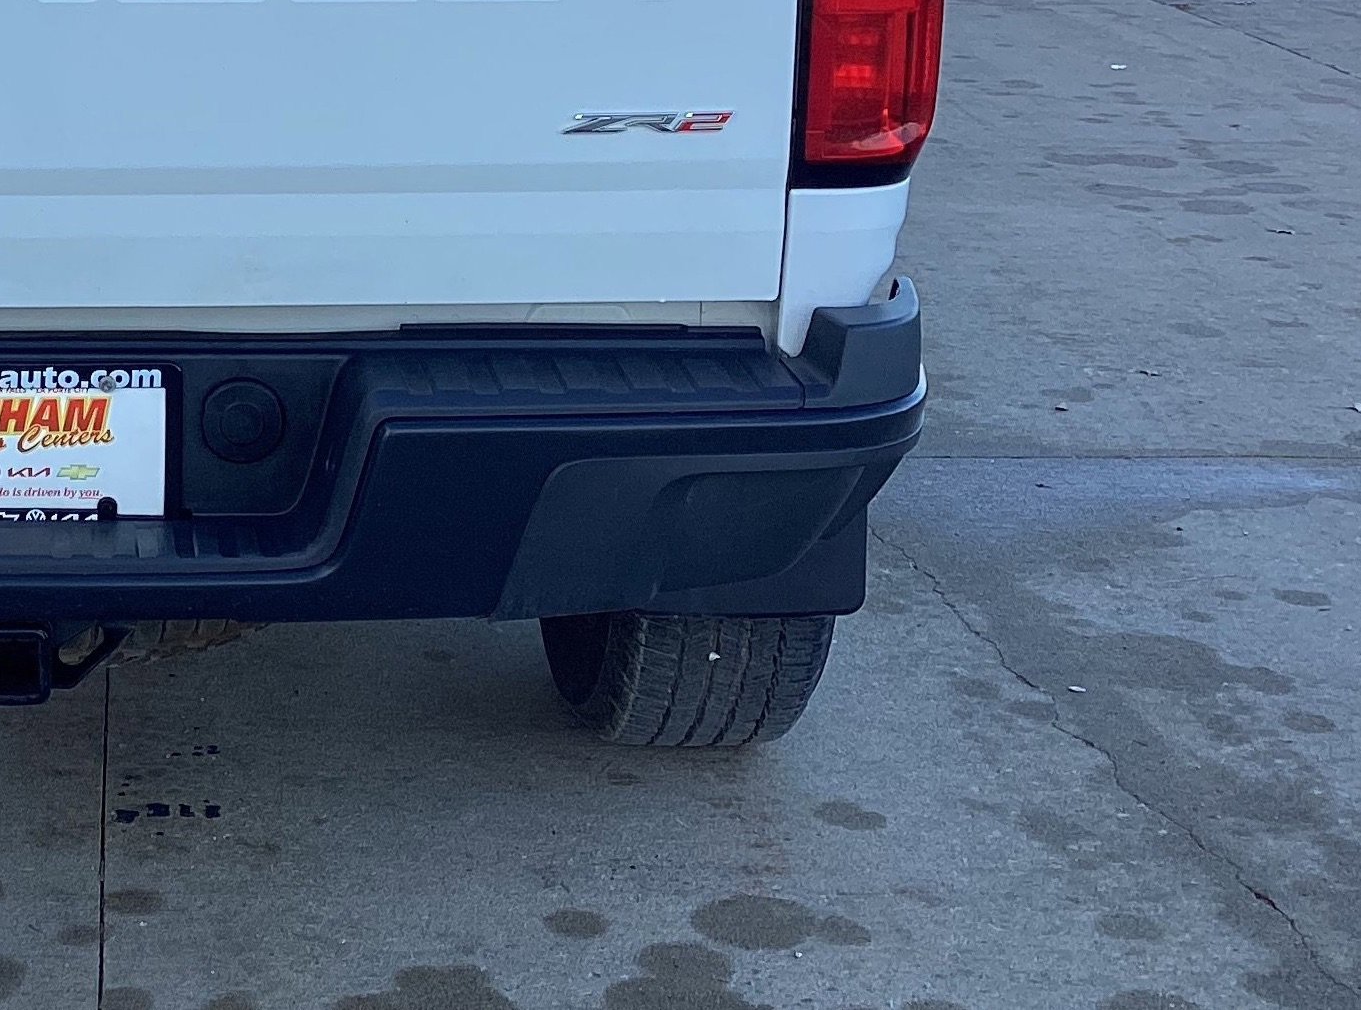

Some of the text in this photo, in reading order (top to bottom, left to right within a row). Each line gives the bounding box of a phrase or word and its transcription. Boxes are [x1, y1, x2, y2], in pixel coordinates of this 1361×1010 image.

[560, 111, 735, 135] ZR2
[17, 424, 115, 454] Centers
[13, 487, 21, 497] is
[24, 487, 61, 497] driven
[64, 487, 77, 499] by
